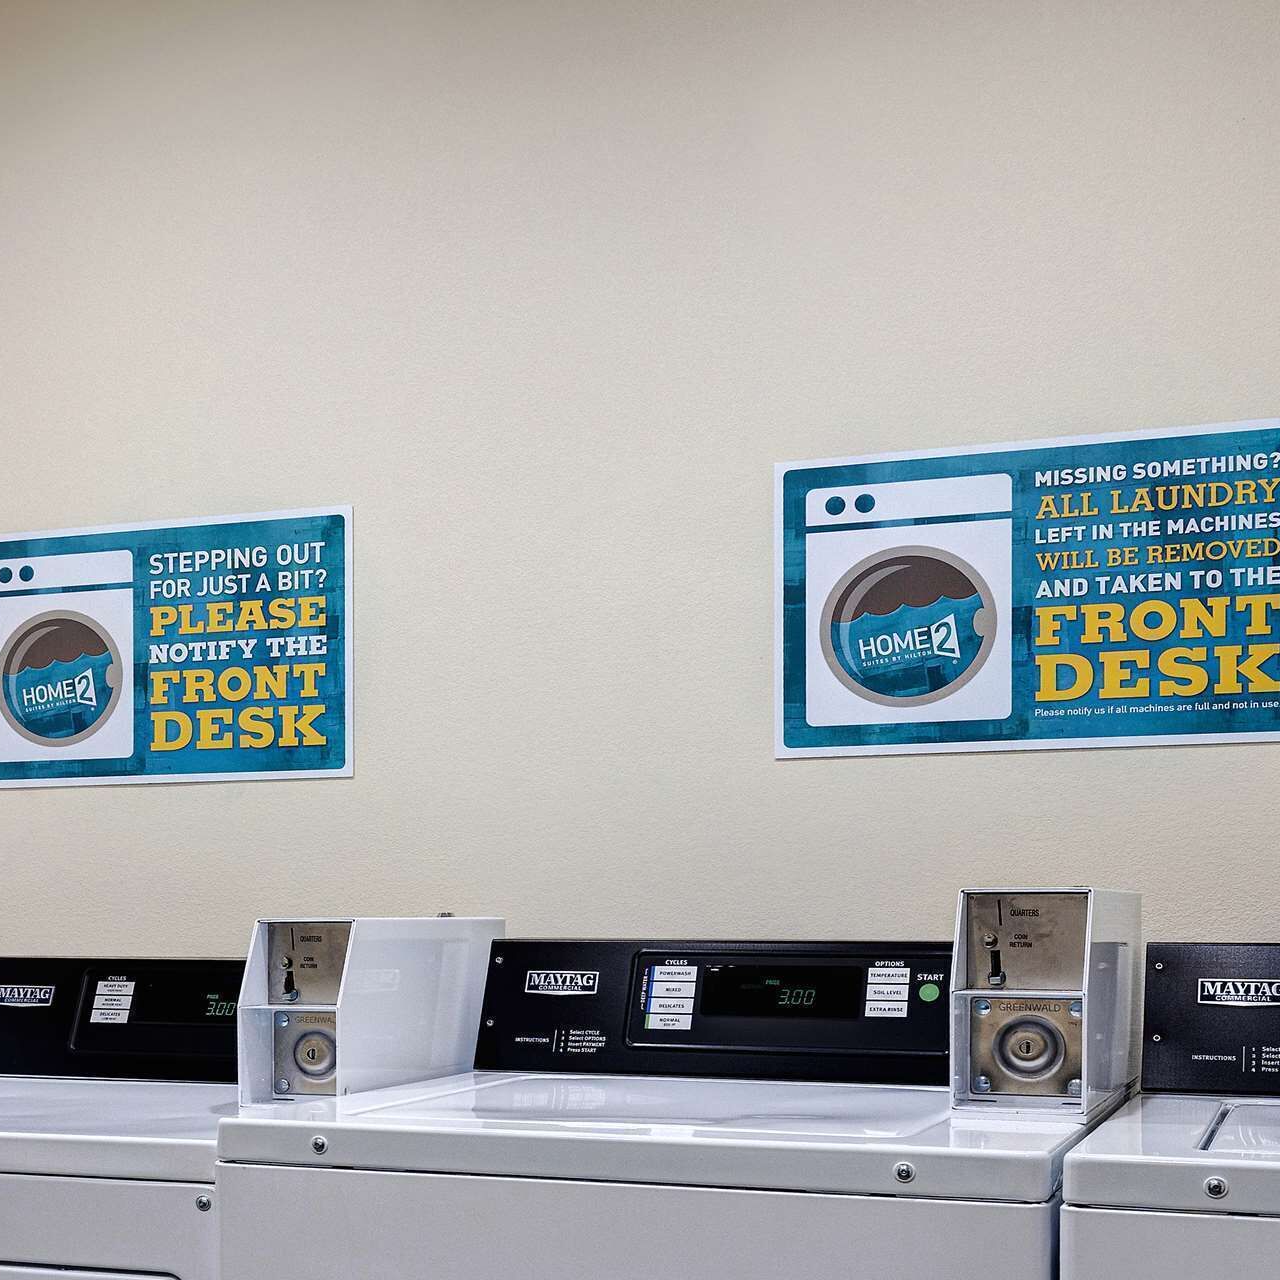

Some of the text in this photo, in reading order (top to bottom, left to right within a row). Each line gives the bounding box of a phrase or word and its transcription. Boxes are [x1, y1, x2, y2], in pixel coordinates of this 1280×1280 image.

[1035, 464, 1128, 488] MISSING
[1035, 492, 1099, 520] ALL
[1035, 525, 1087, 545] LEFT
[1092, 523, 1114, 541] IN
[1119, 520, 1162, 539] THE
[149, 541, 327, 575] STEPPING OUT
[1035, 550, 1100, 572] WILL
[1106, 548, 1140, 567] BE
[150, 568, 328, 599] FOR JUST A BIT?
[1035, 578, 1089, 599] AND
[1095, 571, 1183, 595] TAKEN
[1189, 568, 1223, 589] TO
[149, 596, 327, 637] PLEASE
[149, 634, 328, 664] NOTIFY THE
[858, 614, 960, 660] HOME2
[862, 658, 890, 668] SUITES
[904, 650, 933, 660] HILTON
[22, 668, 97, 706] HOME2
[149, 662, 327, 705] FRONT
[1034, 708, 1066, 718] Please
[1067, 706, 1093, 717] notify
[1094, 706, 1106, 714] us
[1107, 705, 1115, 714] if
[1115, 705, 1128, 714] all
[1129, 703, 1175, 713] machines
[1176, 704, 1193, 712] are
[1194, 702, 1211, 711] full
[1212, 701, 1231, 710] and
[1232, 700, 1248, 709] not
[1249, 700, 1260, 709] in
[150, 704, 327, 752] DESK
[1009, 909, 1040, 917] QUARTERS
[530, 973, 594, 987] MAYTAG
[917, 973, 944, 981] START
[206, 1001, 236, 1016] 3.00
[778, 989, 816, 1005] 3.00
[999, 1003, 1061, 1012] GREENWALD
[295, 1016, 337, 1024] GREENWAL
